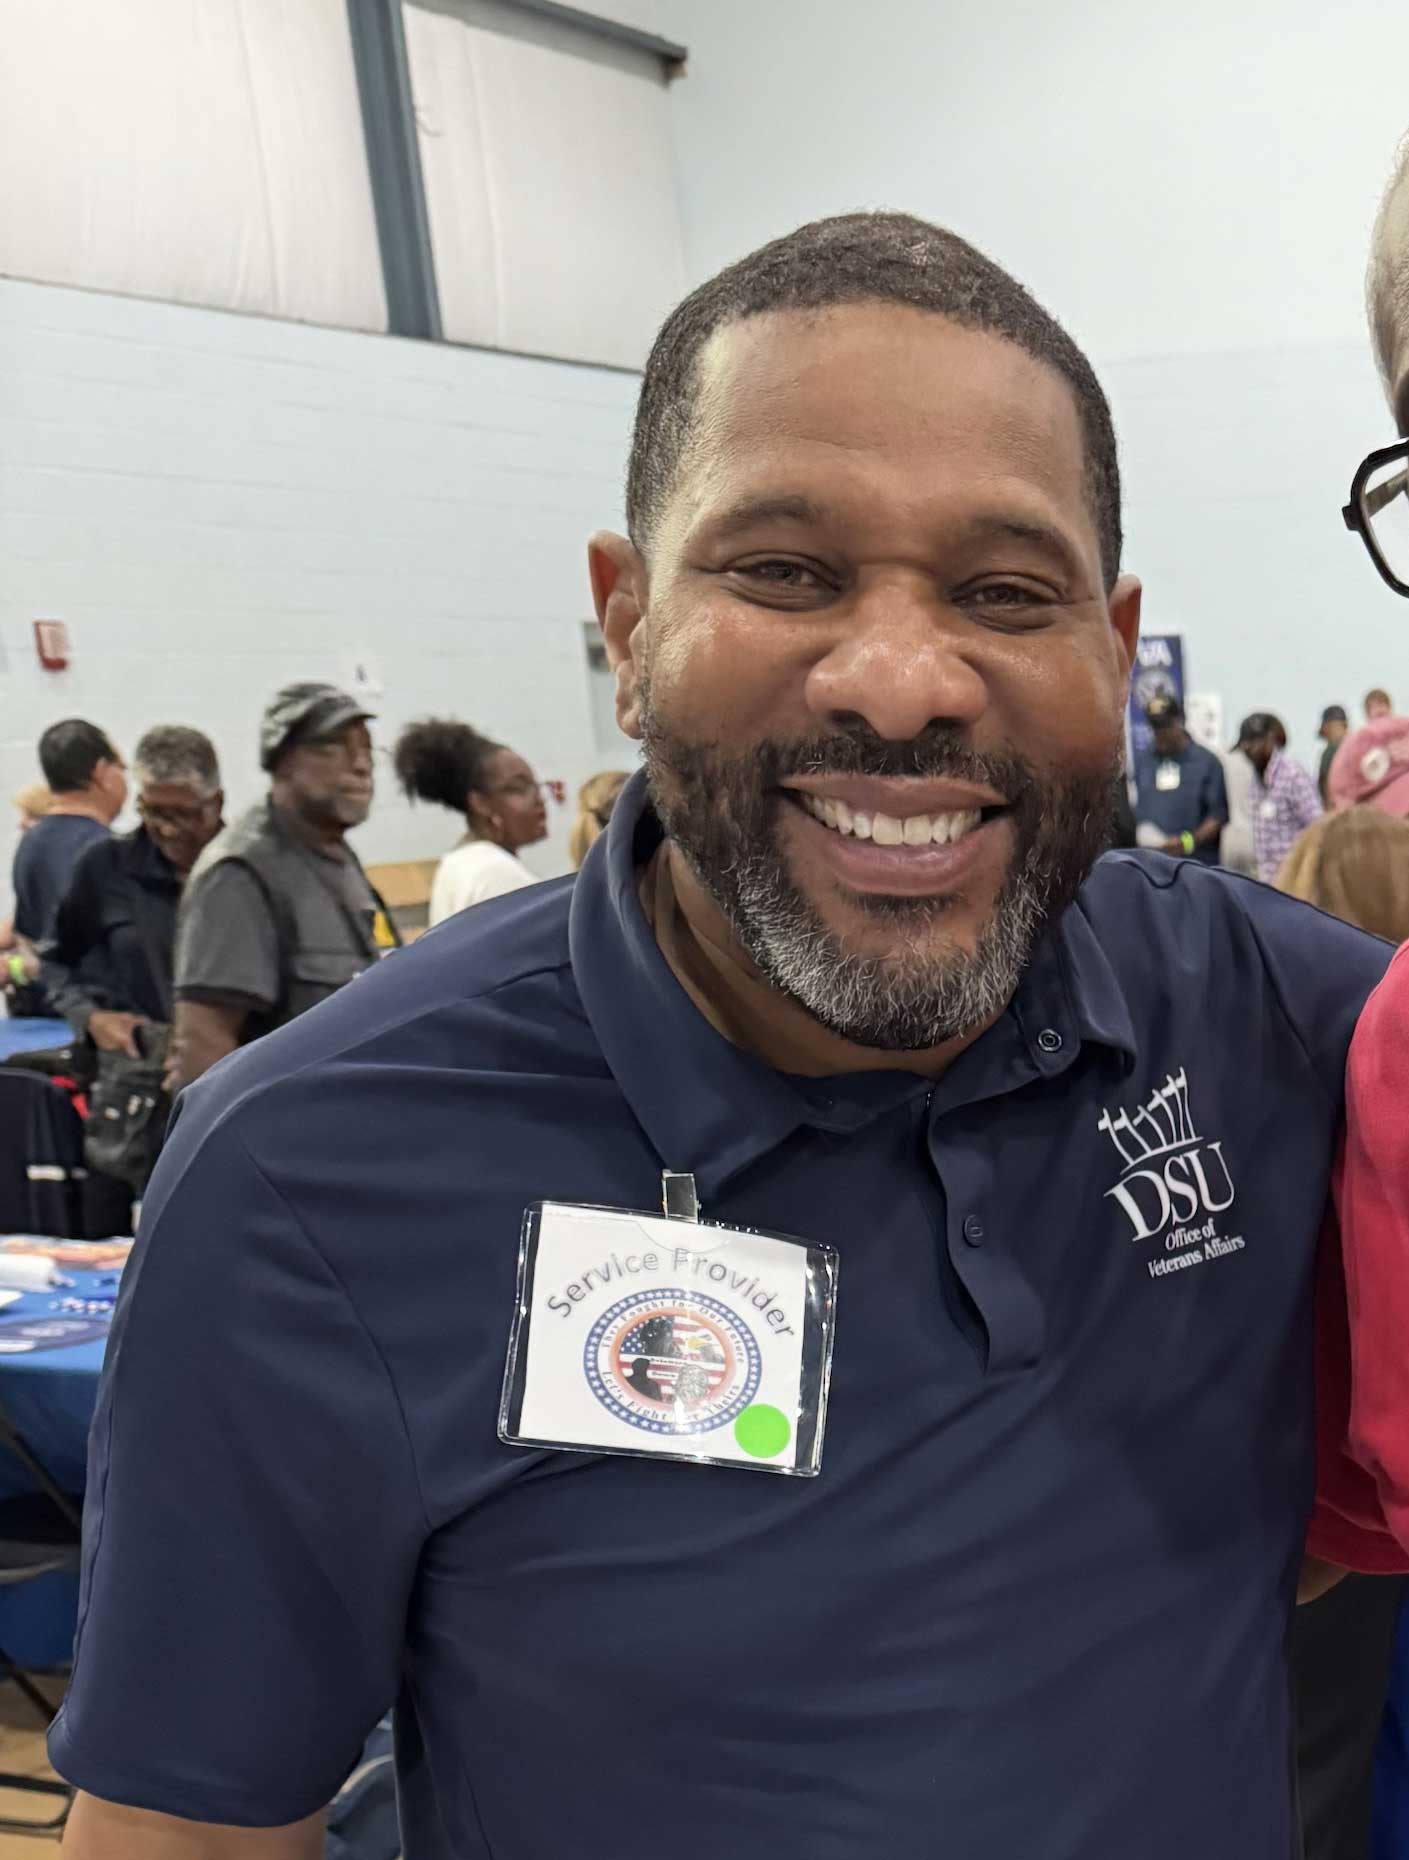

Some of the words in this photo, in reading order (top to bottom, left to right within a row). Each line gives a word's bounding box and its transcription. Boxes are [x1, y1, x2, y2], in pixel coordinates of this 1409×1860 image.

[1103, 1141, 1235, 1242] DSU
[1147, 1249, 1204, 1278] Veterans
[1204, 1235, 1246, 1261] Affairs
[1165, 1226, 1202, 1251] Office
[1202, 1217, 1217, 1240] of
[547, 1250, 660, 1318] Service
[673, 1247, 795, 1339] Provider
